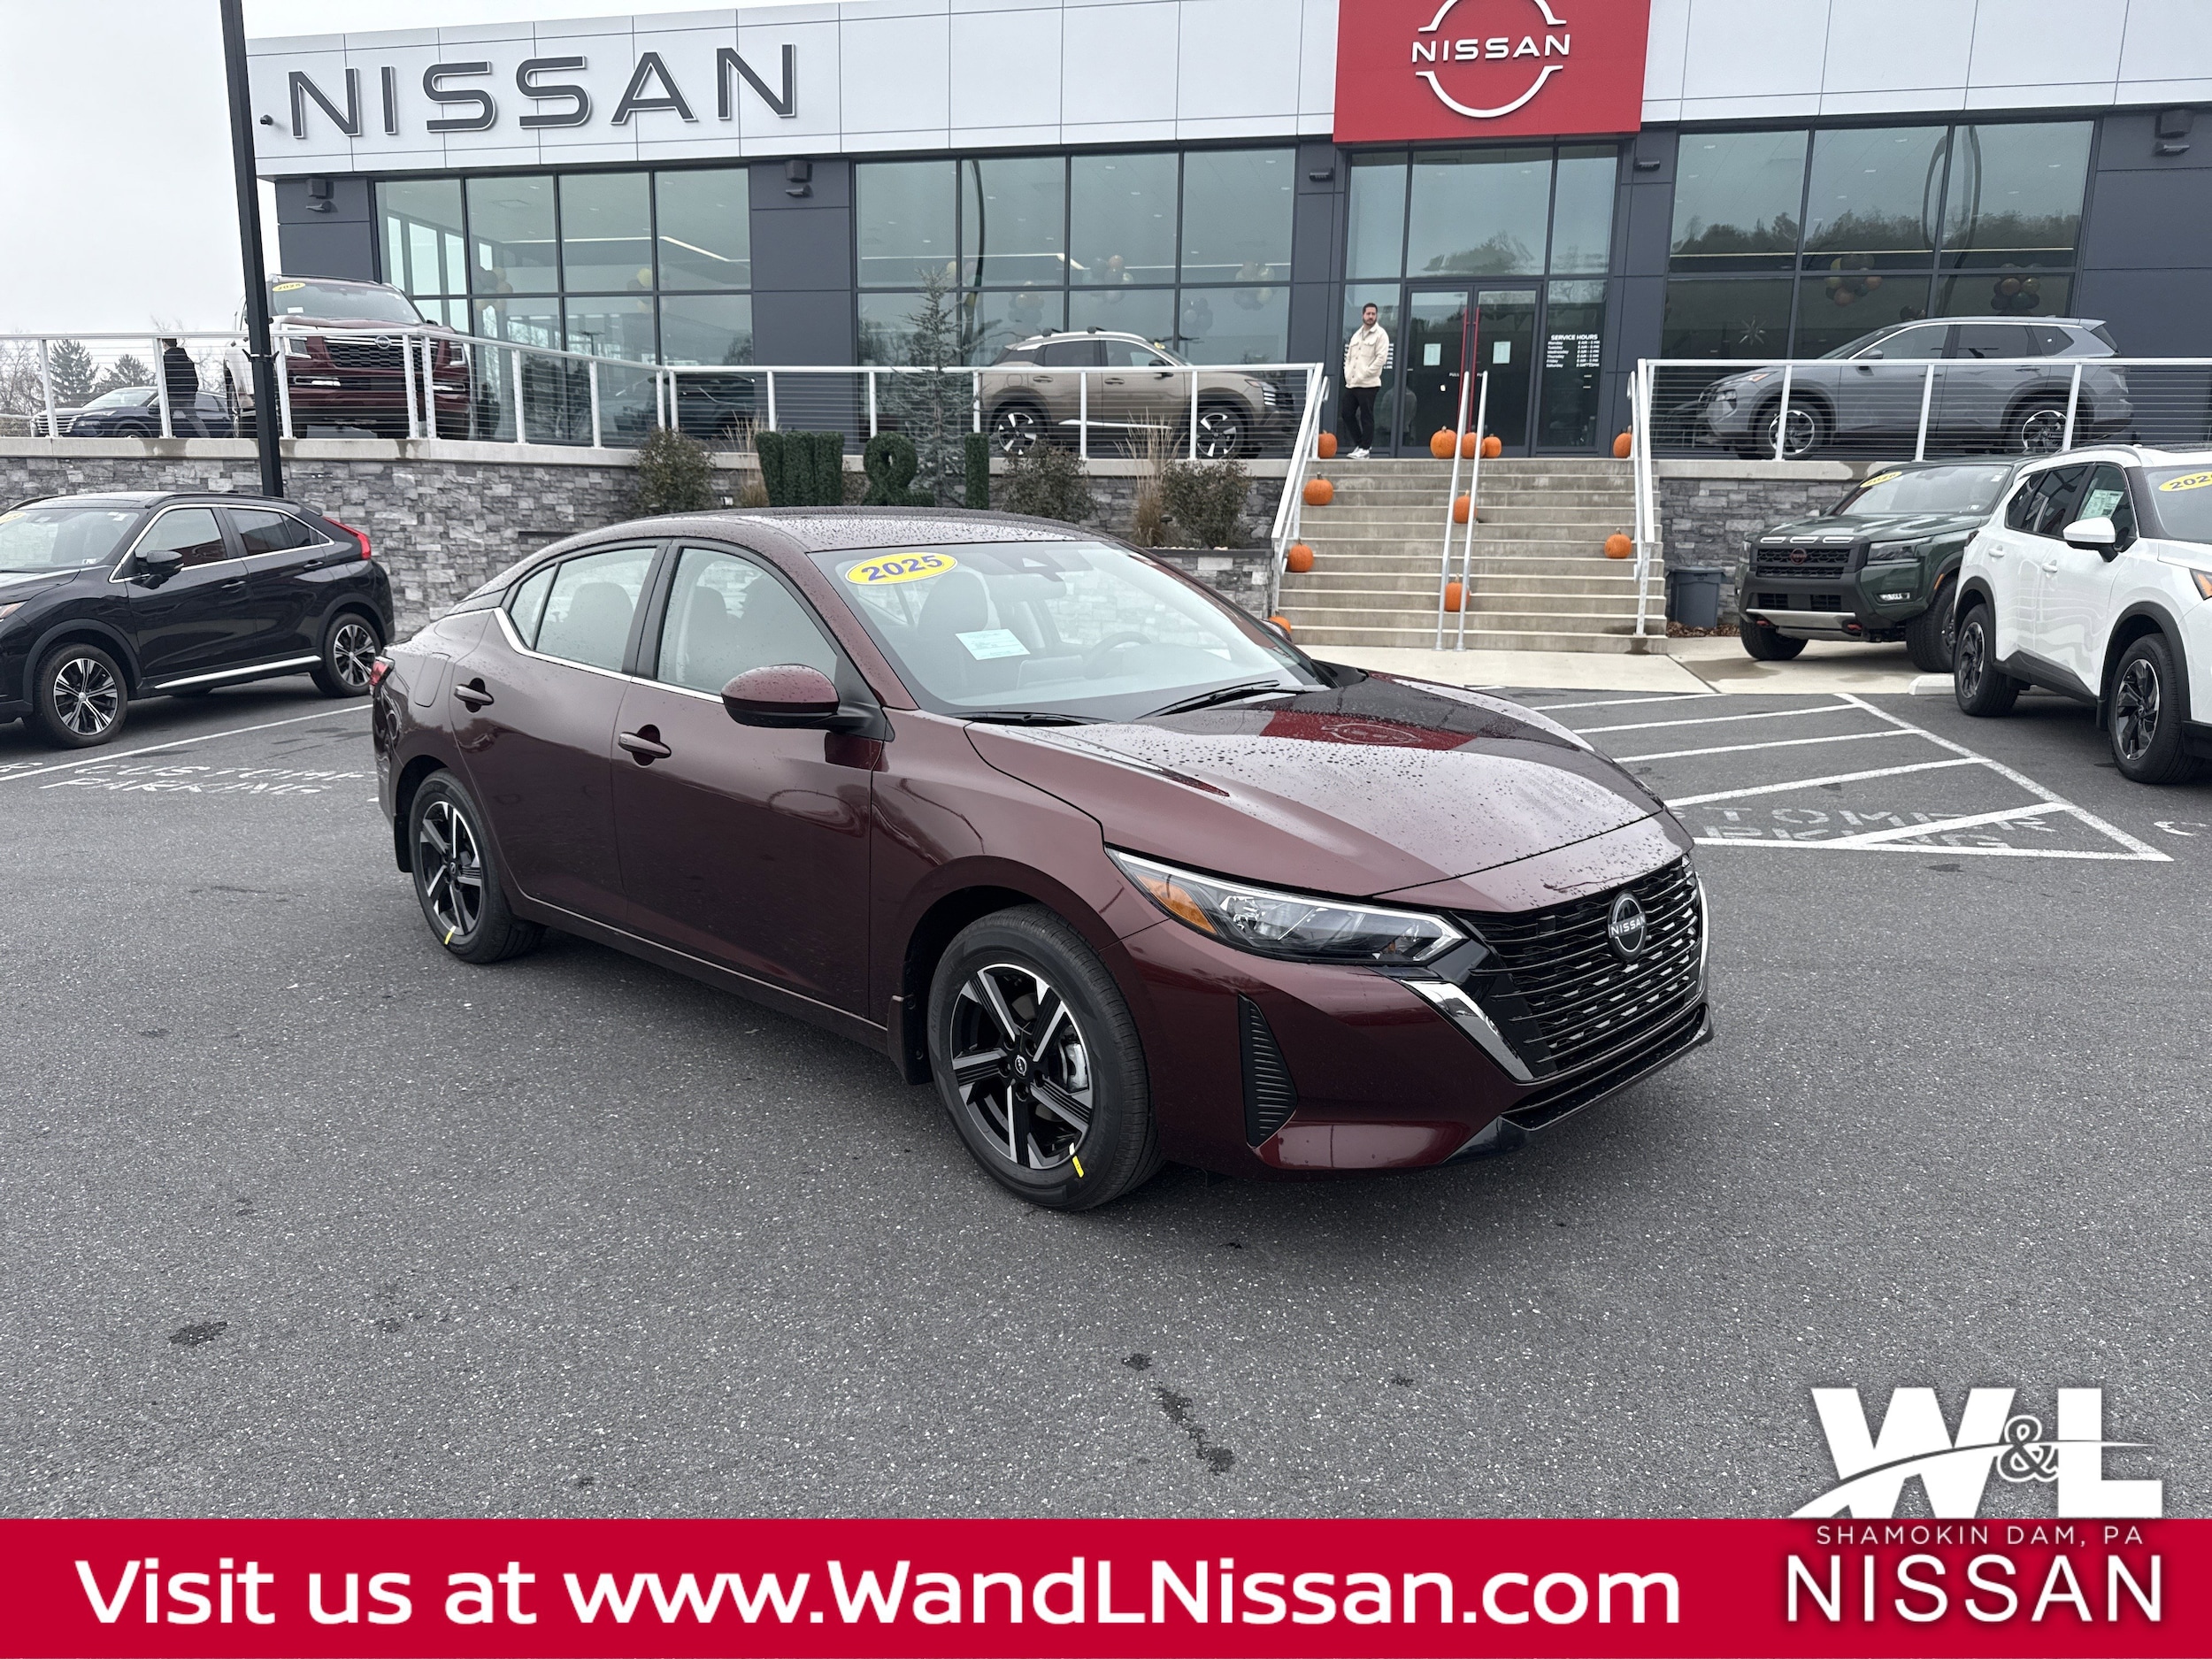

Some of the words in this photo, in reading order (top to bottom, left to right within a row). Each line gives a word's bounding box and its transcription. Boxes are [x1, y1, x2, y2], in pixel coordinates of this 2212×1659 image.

[1411, 34, 1571, 63] NISSAN
[288, 43, 796, 139] NISSAN
[2170, 474, 2212, 489] 202
[861, 555, 943, 581] 2025
[39, 778, 333, 795] PARKING
[1610, 916, 1646, 936] NISSAN
